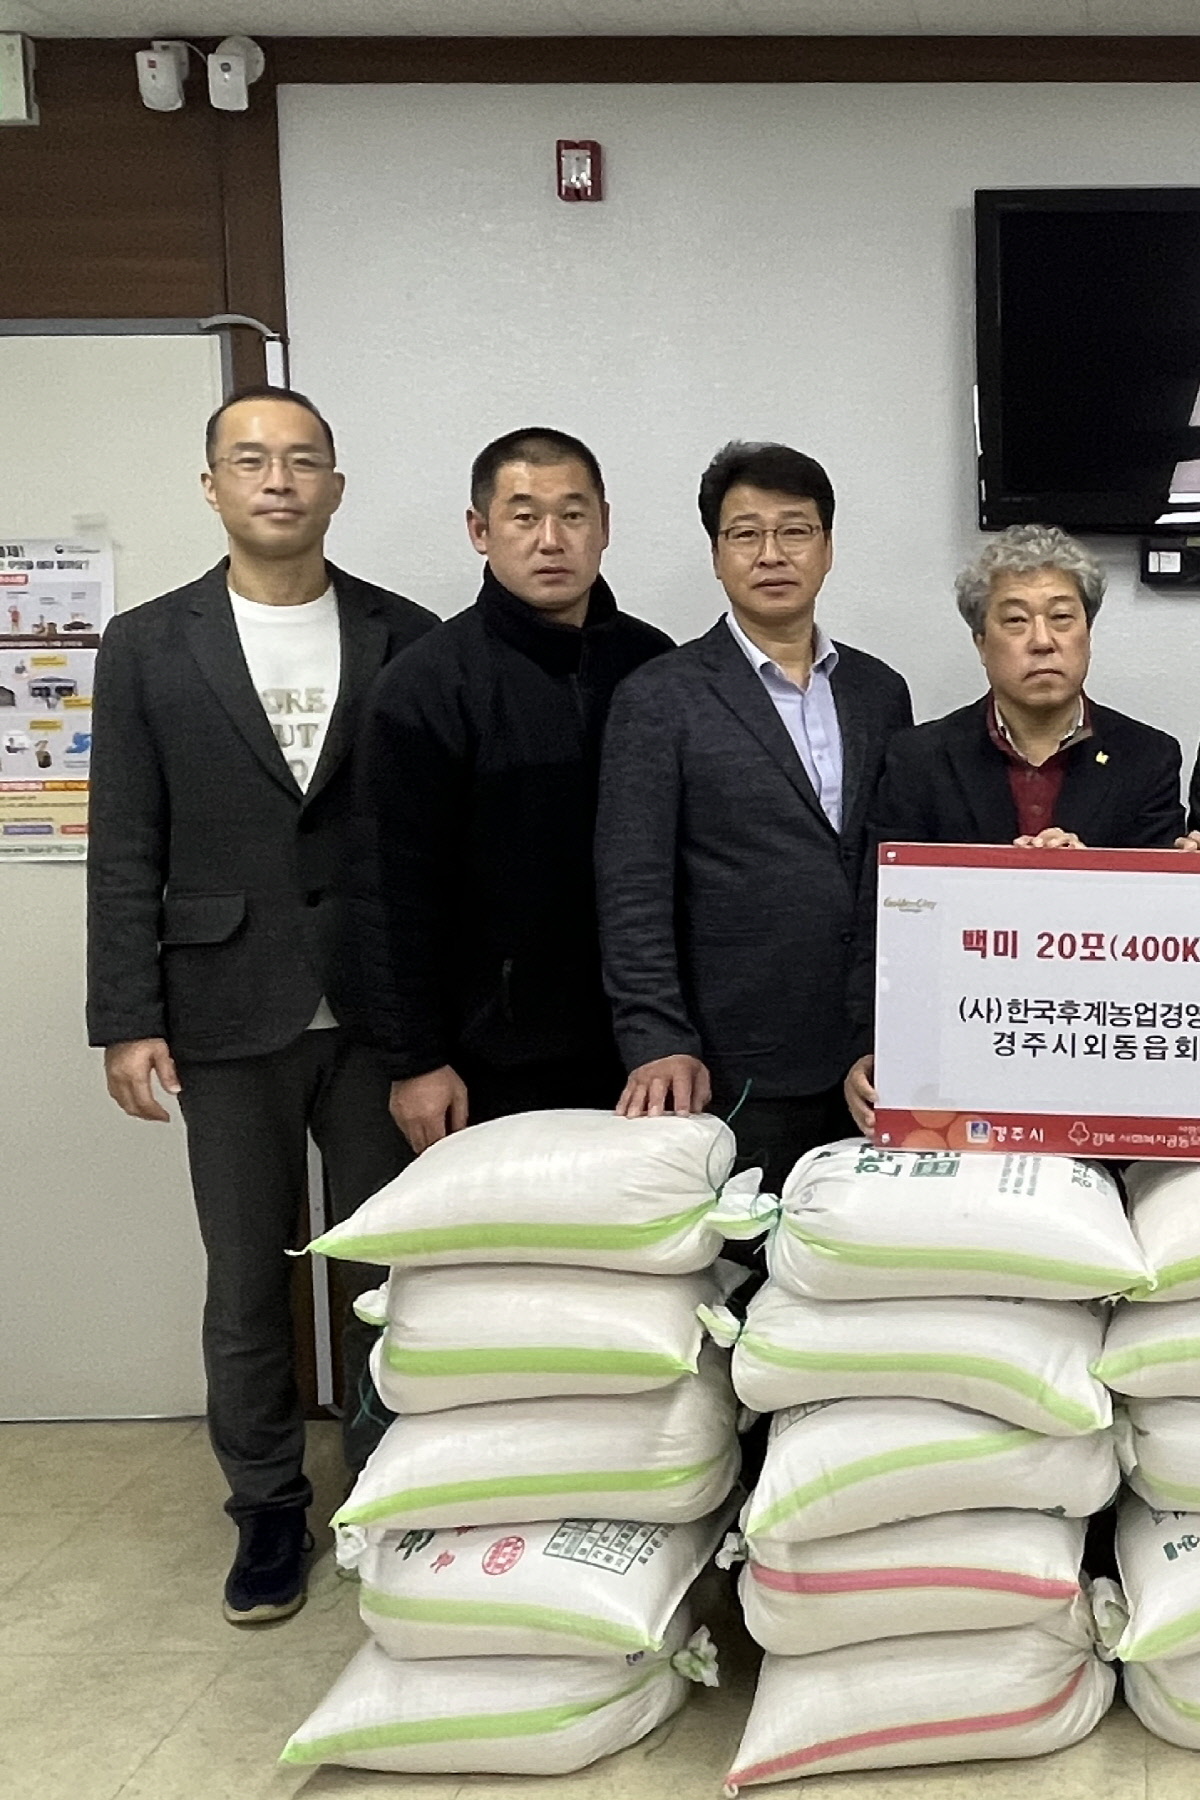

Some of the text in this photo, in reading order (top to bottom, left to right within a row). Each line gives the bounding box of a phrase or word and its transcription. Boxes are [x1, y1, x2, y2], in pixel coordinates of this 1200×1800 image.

[962, 928, 1018, 960] 백미
[992, 1031, 1198, 1062] 경주시외동읍회
[992, 1126, 1044, 1143] 경주시
